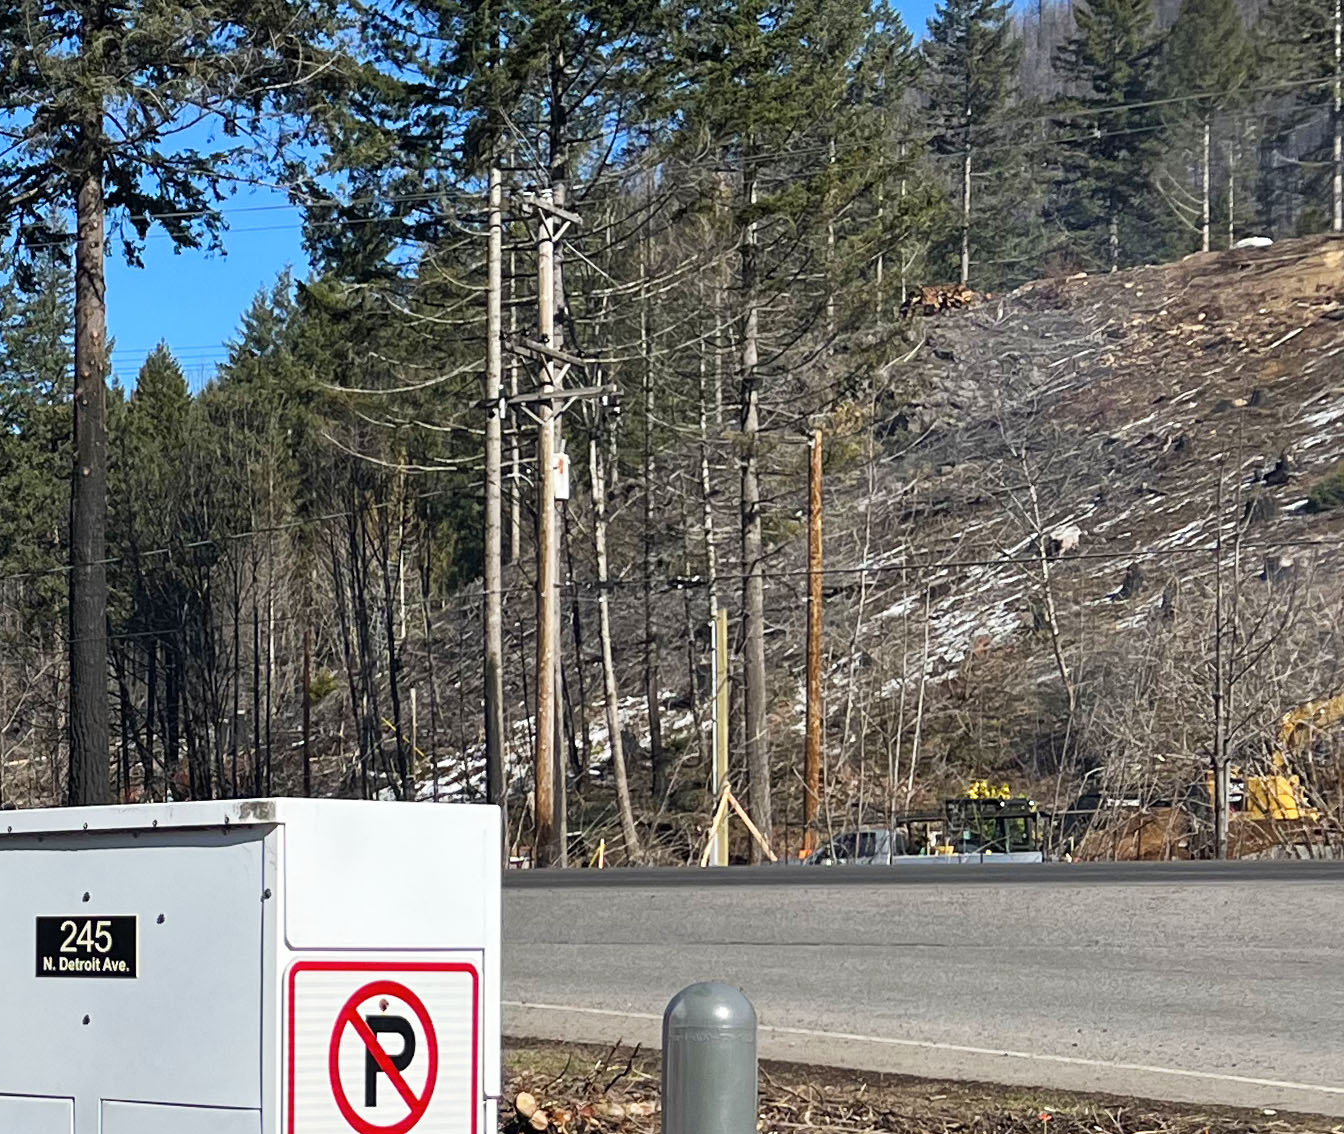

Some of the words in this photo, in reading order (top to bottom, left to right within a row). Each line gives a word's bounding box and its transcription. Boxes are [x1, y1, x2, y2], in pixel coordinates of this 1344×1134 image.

[59, 920, 113, 953] 245
[43, 957, 56, 971] N.
[58, 957, 101, 972] Detroit
[103, 958, 130, 972] Ave.
